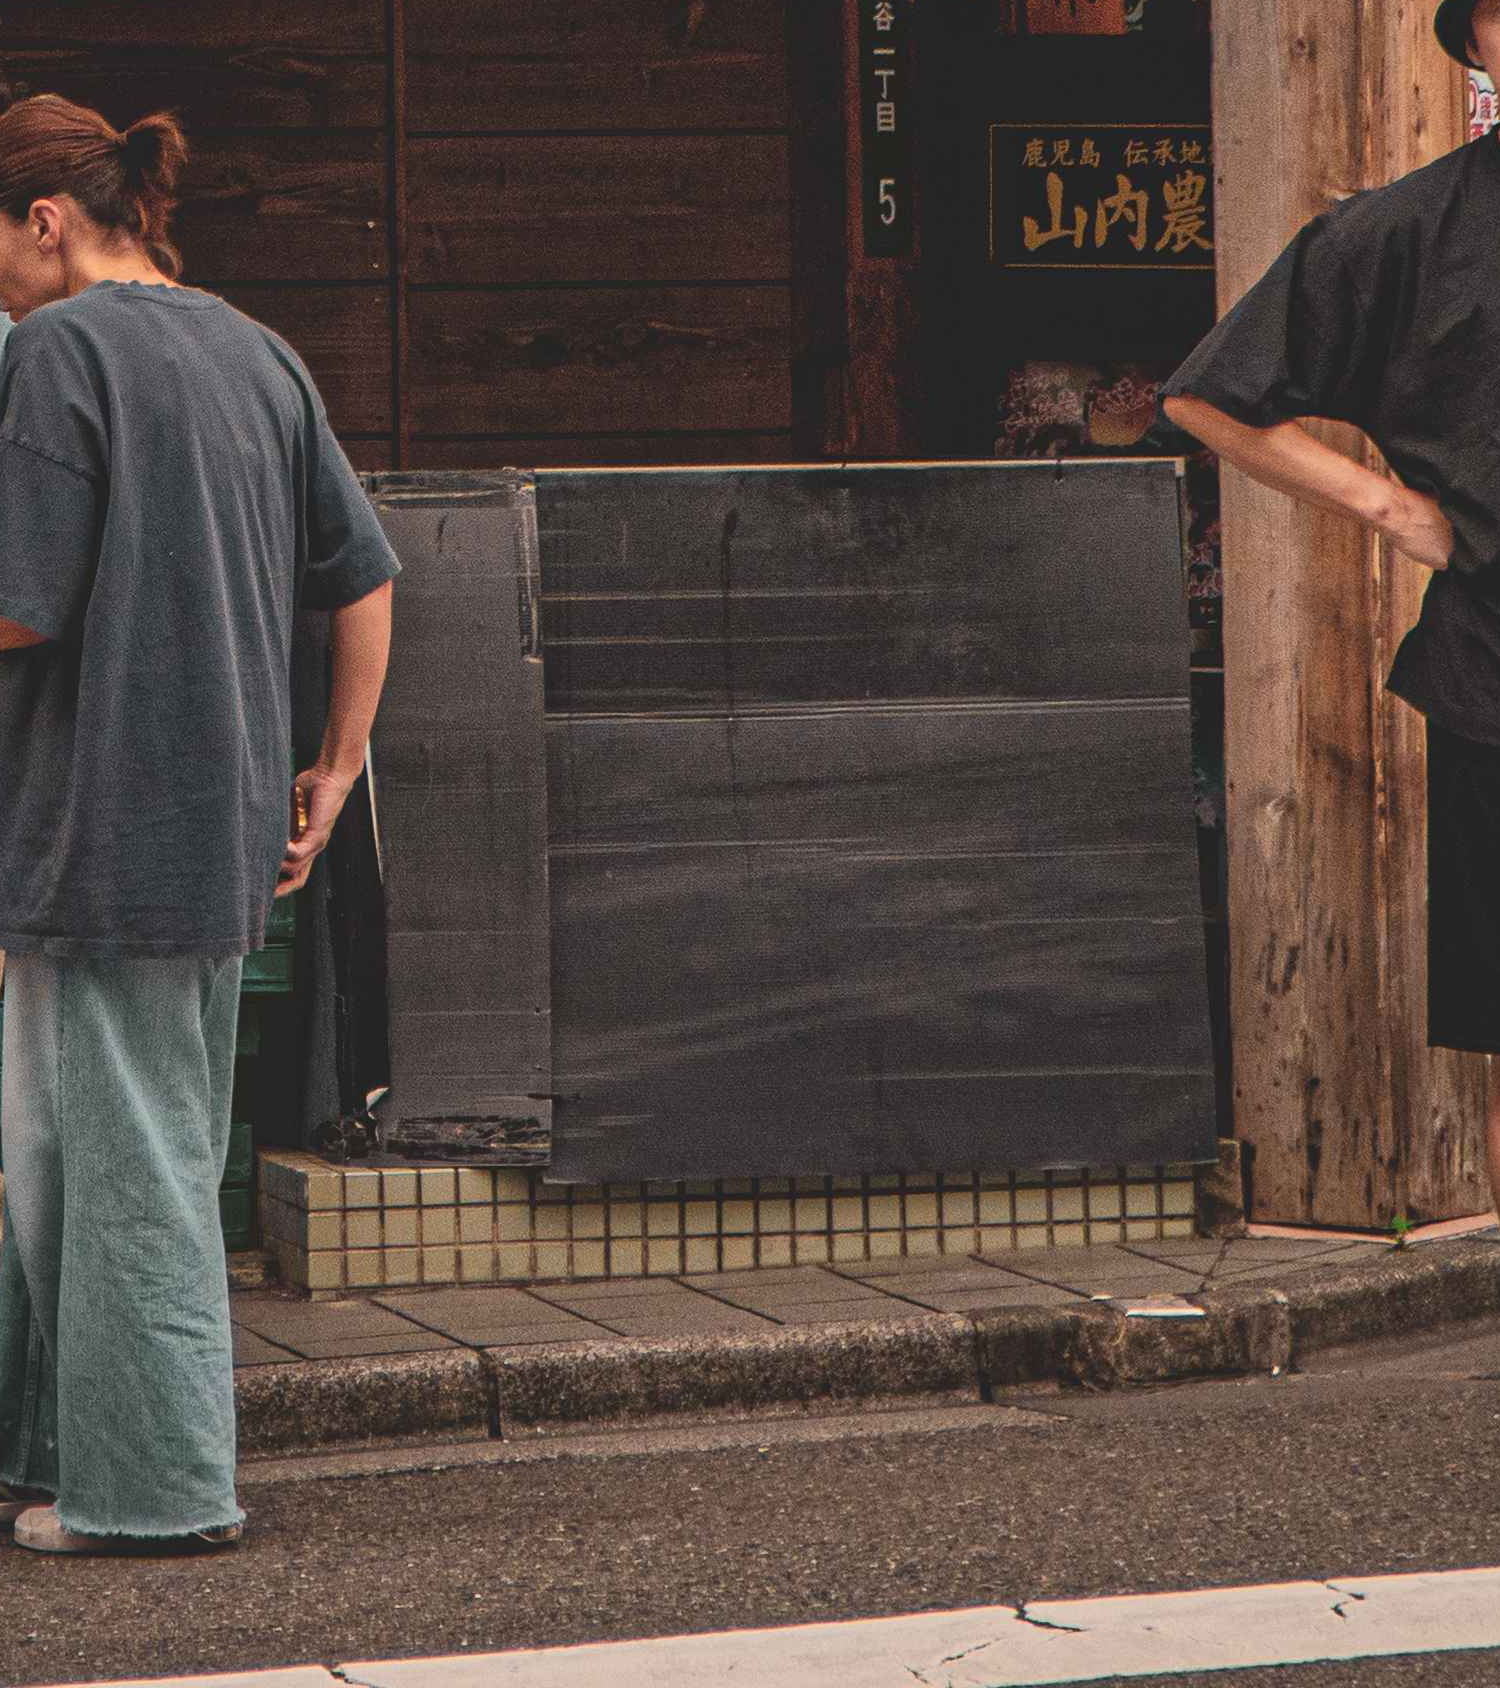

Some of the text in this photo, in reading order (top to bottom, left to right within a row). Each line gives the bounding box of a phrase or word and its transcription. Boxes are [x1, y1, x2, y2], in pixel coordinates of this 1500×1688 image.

[1021, 137, 1213, 170] 鹿児島 伝承地
[880, 179, 896, 226] 5
